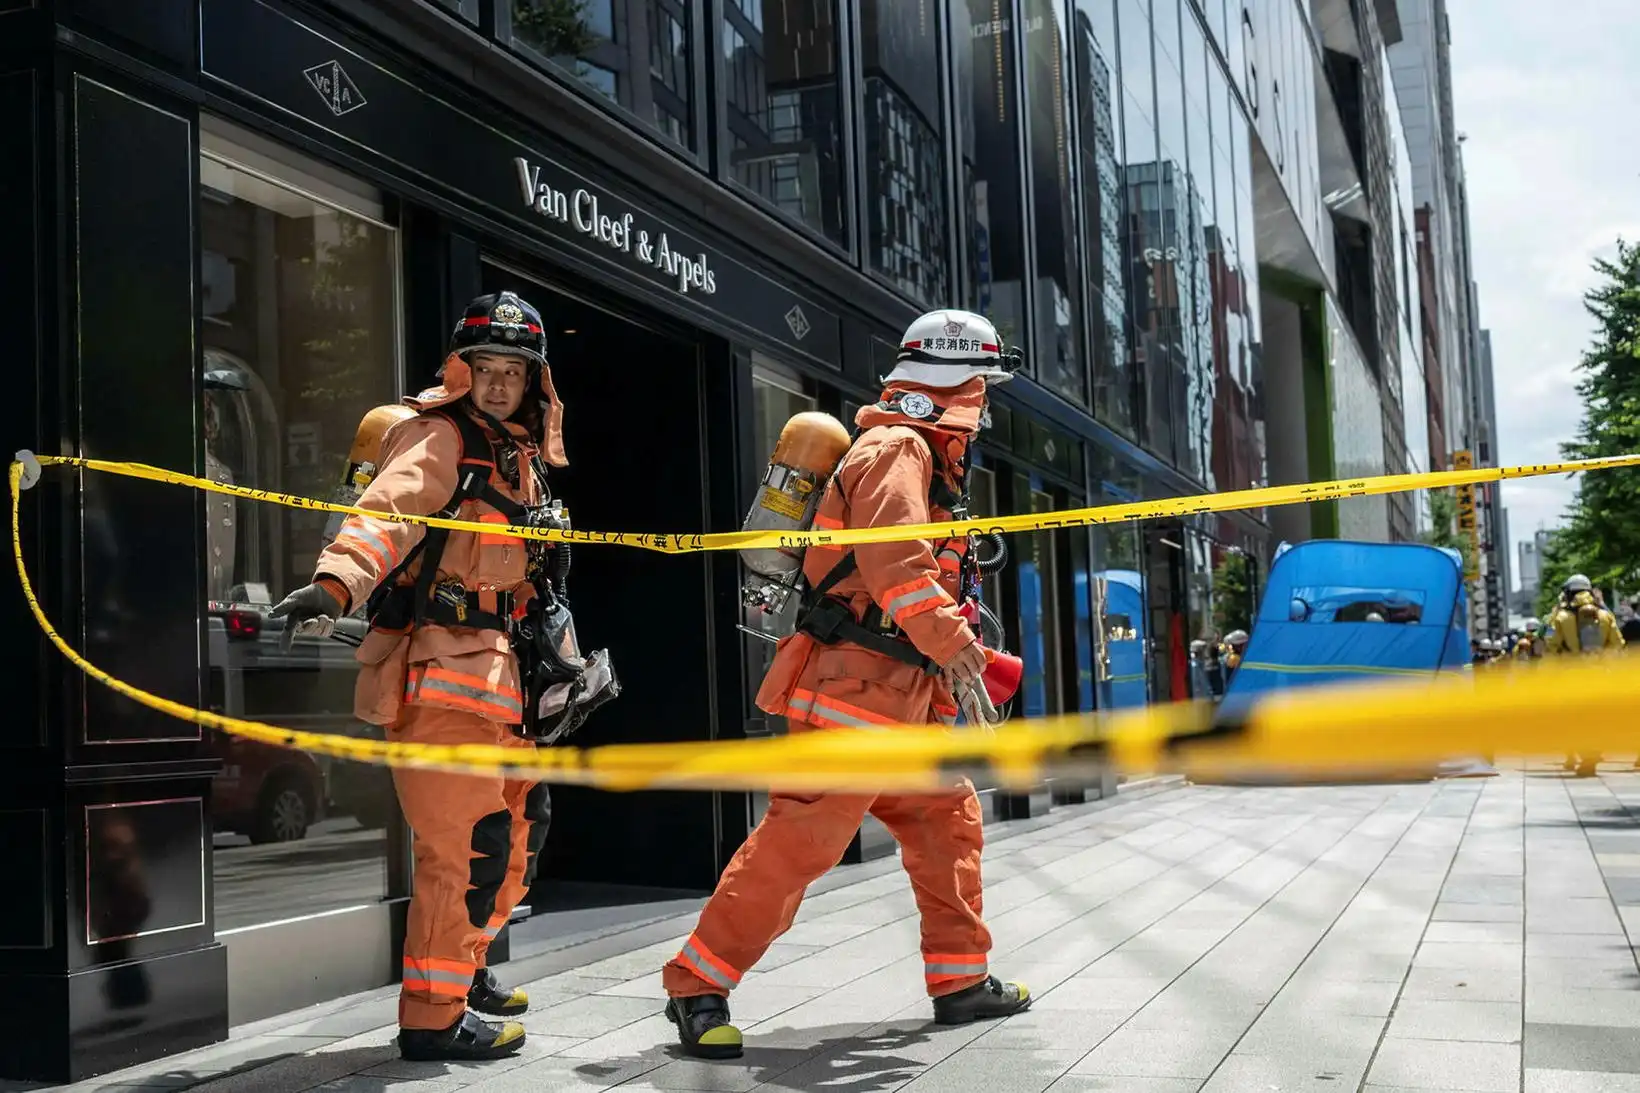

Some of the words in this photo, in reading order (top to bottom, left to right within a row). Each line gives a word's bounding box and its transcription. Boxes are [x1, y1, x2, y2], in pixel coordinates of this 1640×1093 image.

[514, 157, 568, 223] Van
[571, 188, 634, 253] Cleef
[634, 230, 654, 264] &
[655, 232, 716, 294] Arpels
[922, 338, 981, 352] 東京消防庁
